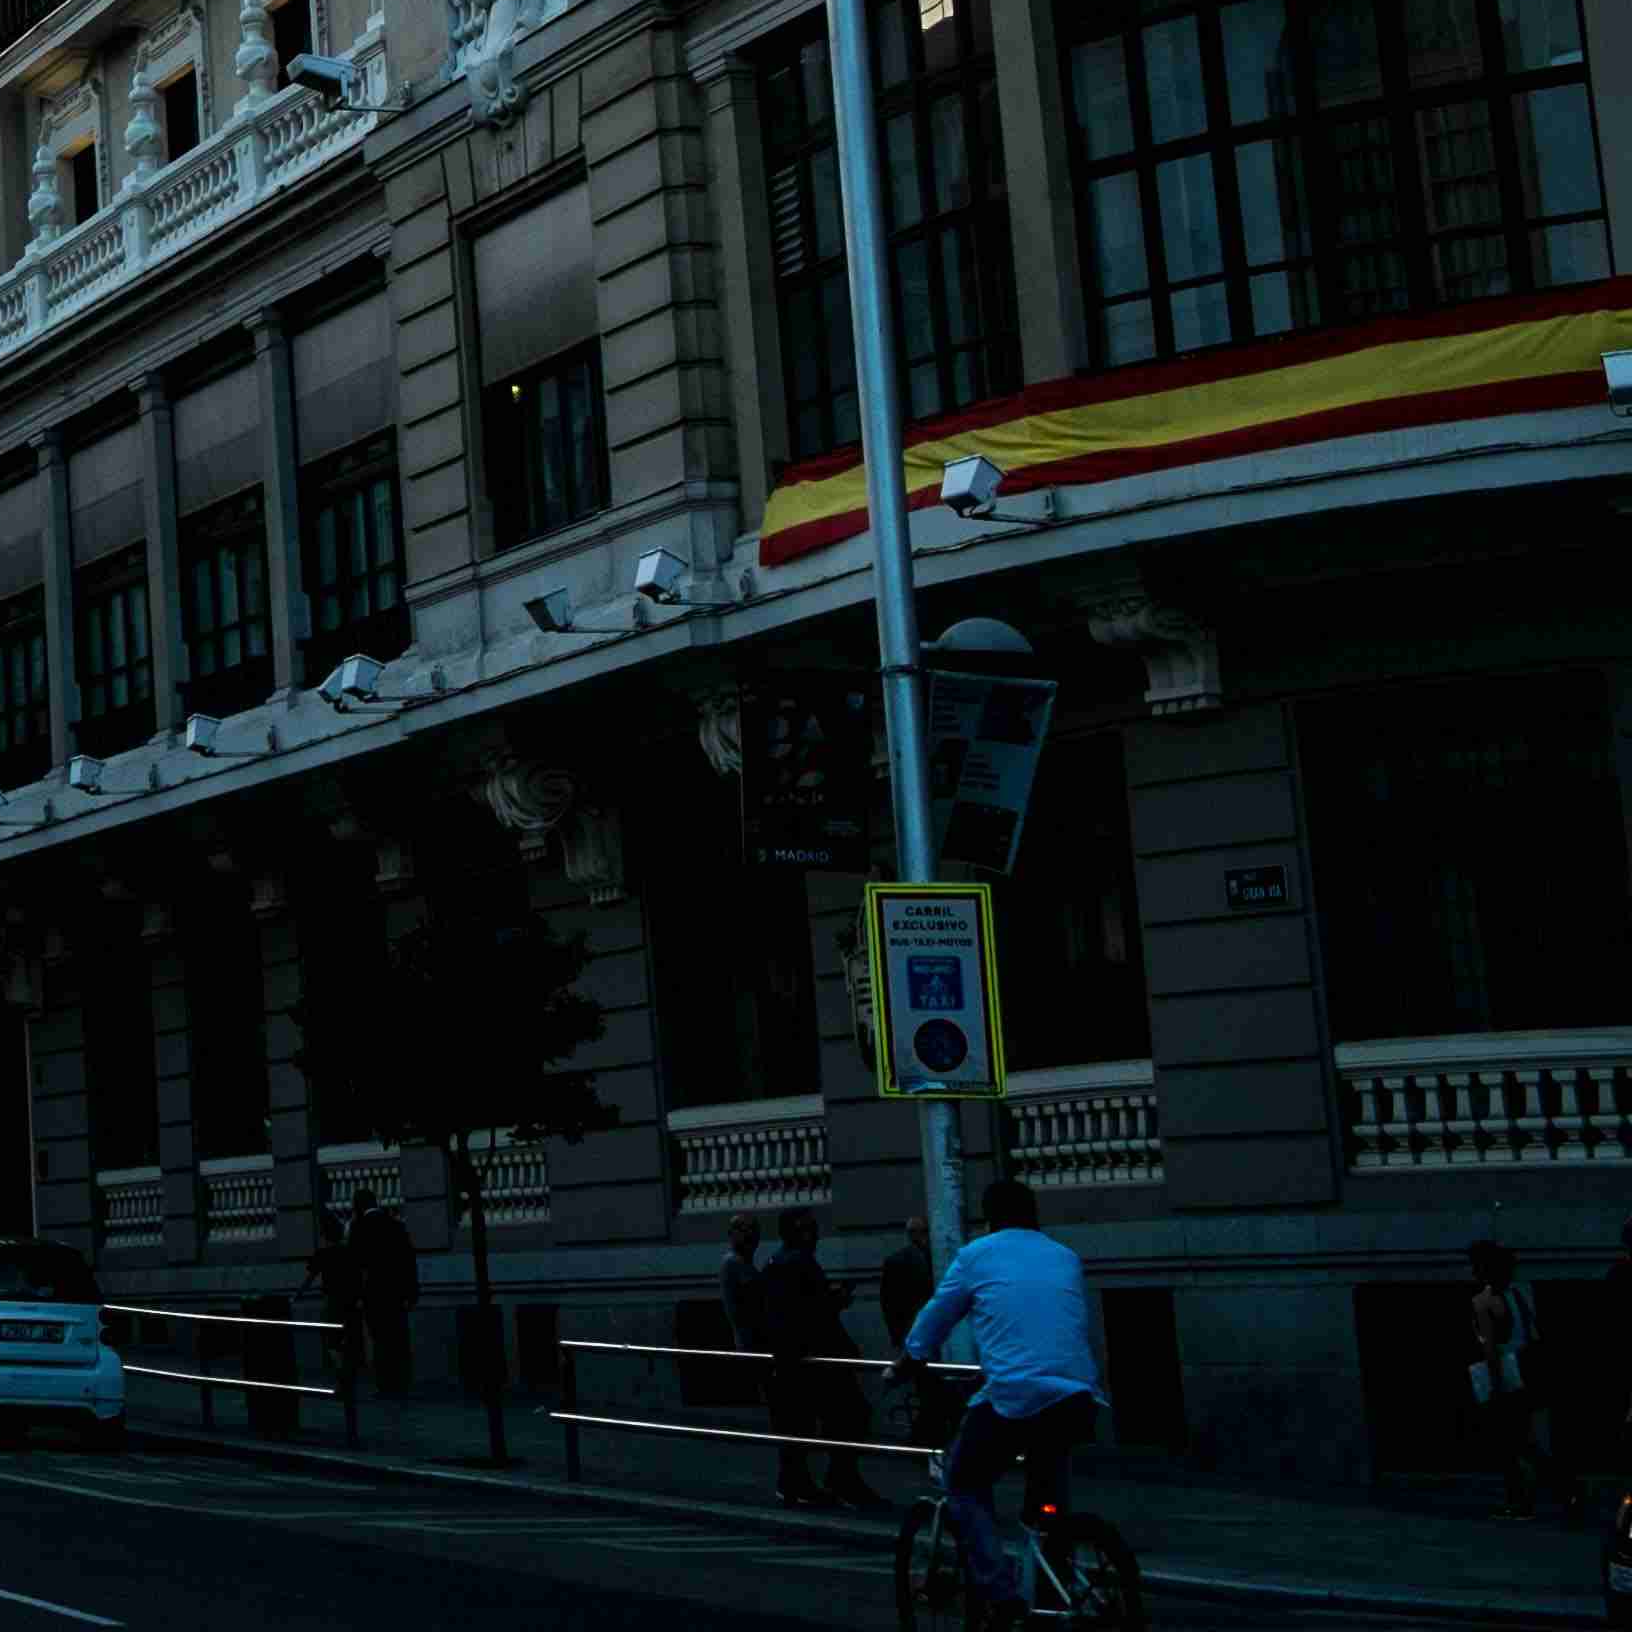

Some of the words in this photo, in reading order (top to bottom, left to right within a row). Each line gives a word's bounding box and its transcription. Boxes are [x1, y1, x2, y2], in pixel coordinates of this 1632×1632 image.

[904, 905, 955, 917] CARRIL
[892, 919, 969, 931] EXCLUSIVO
[919, 993, 957, 1009] TAXI
